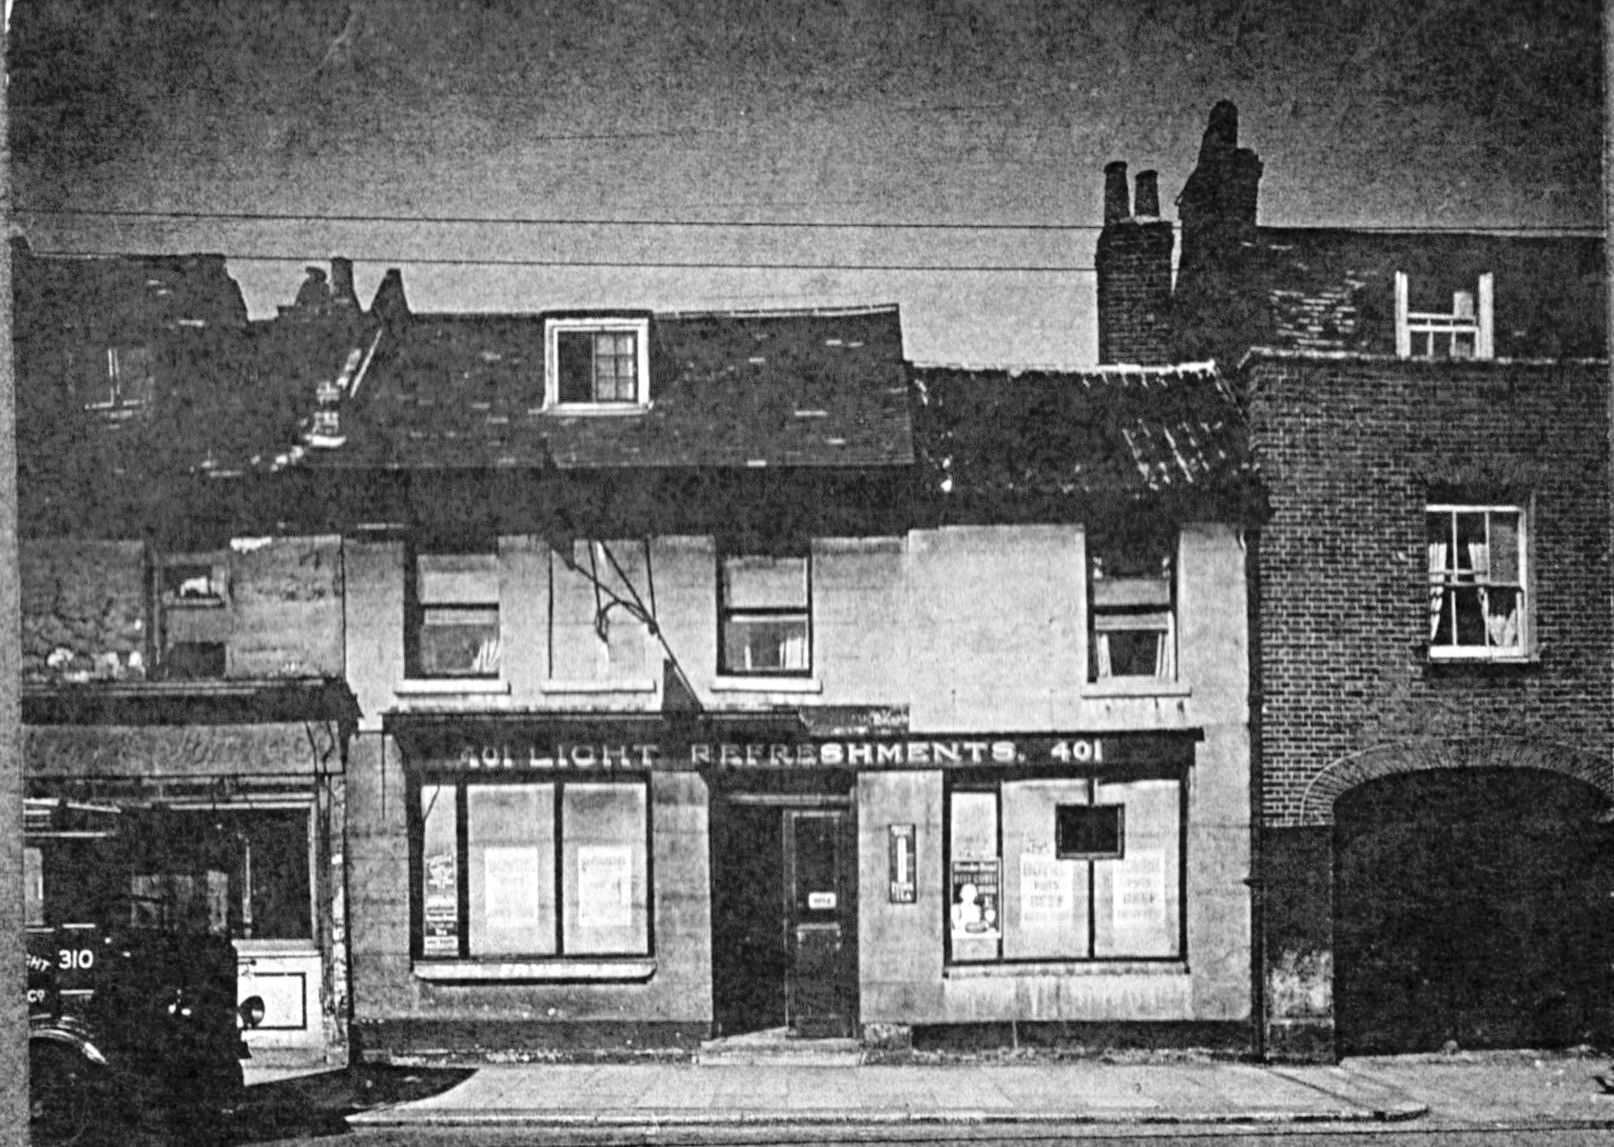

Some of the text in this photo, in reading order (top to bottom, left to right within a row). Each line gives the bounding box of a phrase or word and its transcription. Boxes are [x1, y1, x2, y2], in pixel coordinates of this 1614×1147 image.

[529, 743, 658, 768] LIGHT
[1050, 738, 1103, 763] 401
[58, 949, 94, 969] 310
